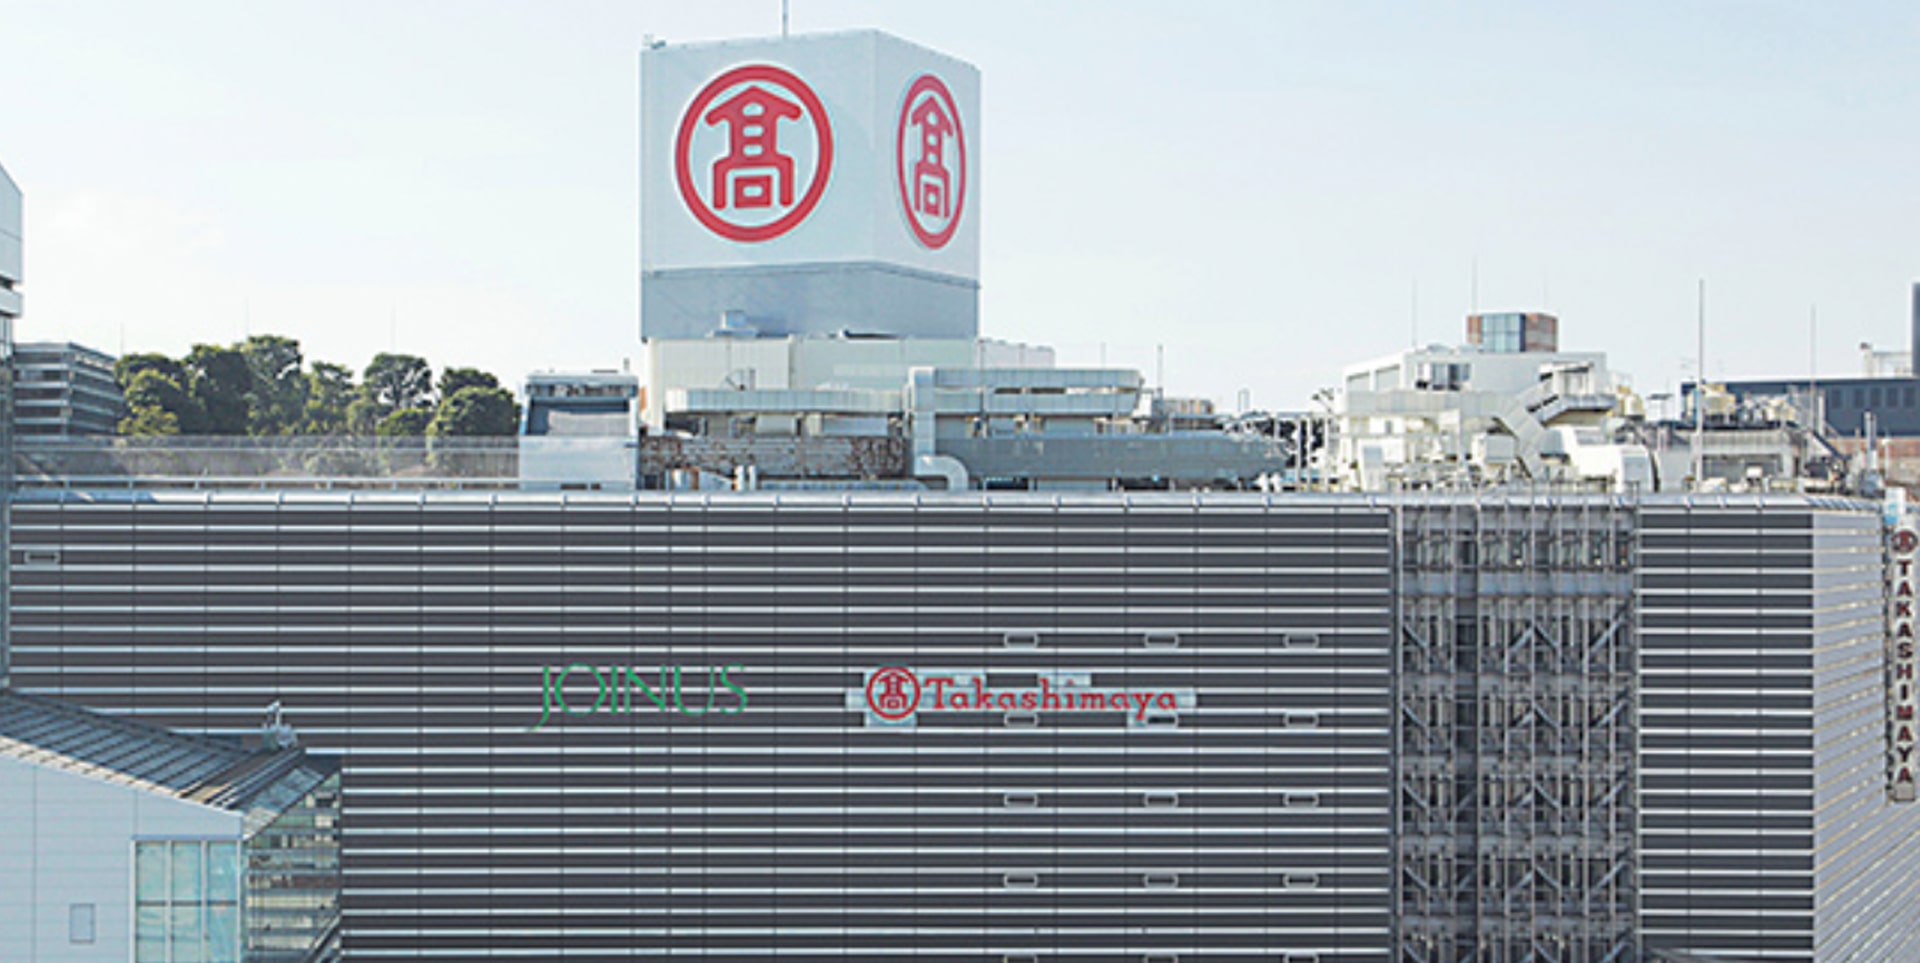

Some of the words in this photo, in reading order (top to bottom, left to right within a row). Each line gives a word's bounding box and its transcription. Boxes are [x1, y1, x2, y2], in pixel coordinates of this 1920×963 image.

[525, 662, 748, 733] JOINUS
[925, 677, 1178, 720] Takashimaya
[1897, 560, 1913, 783] TAKASHIMAYA
